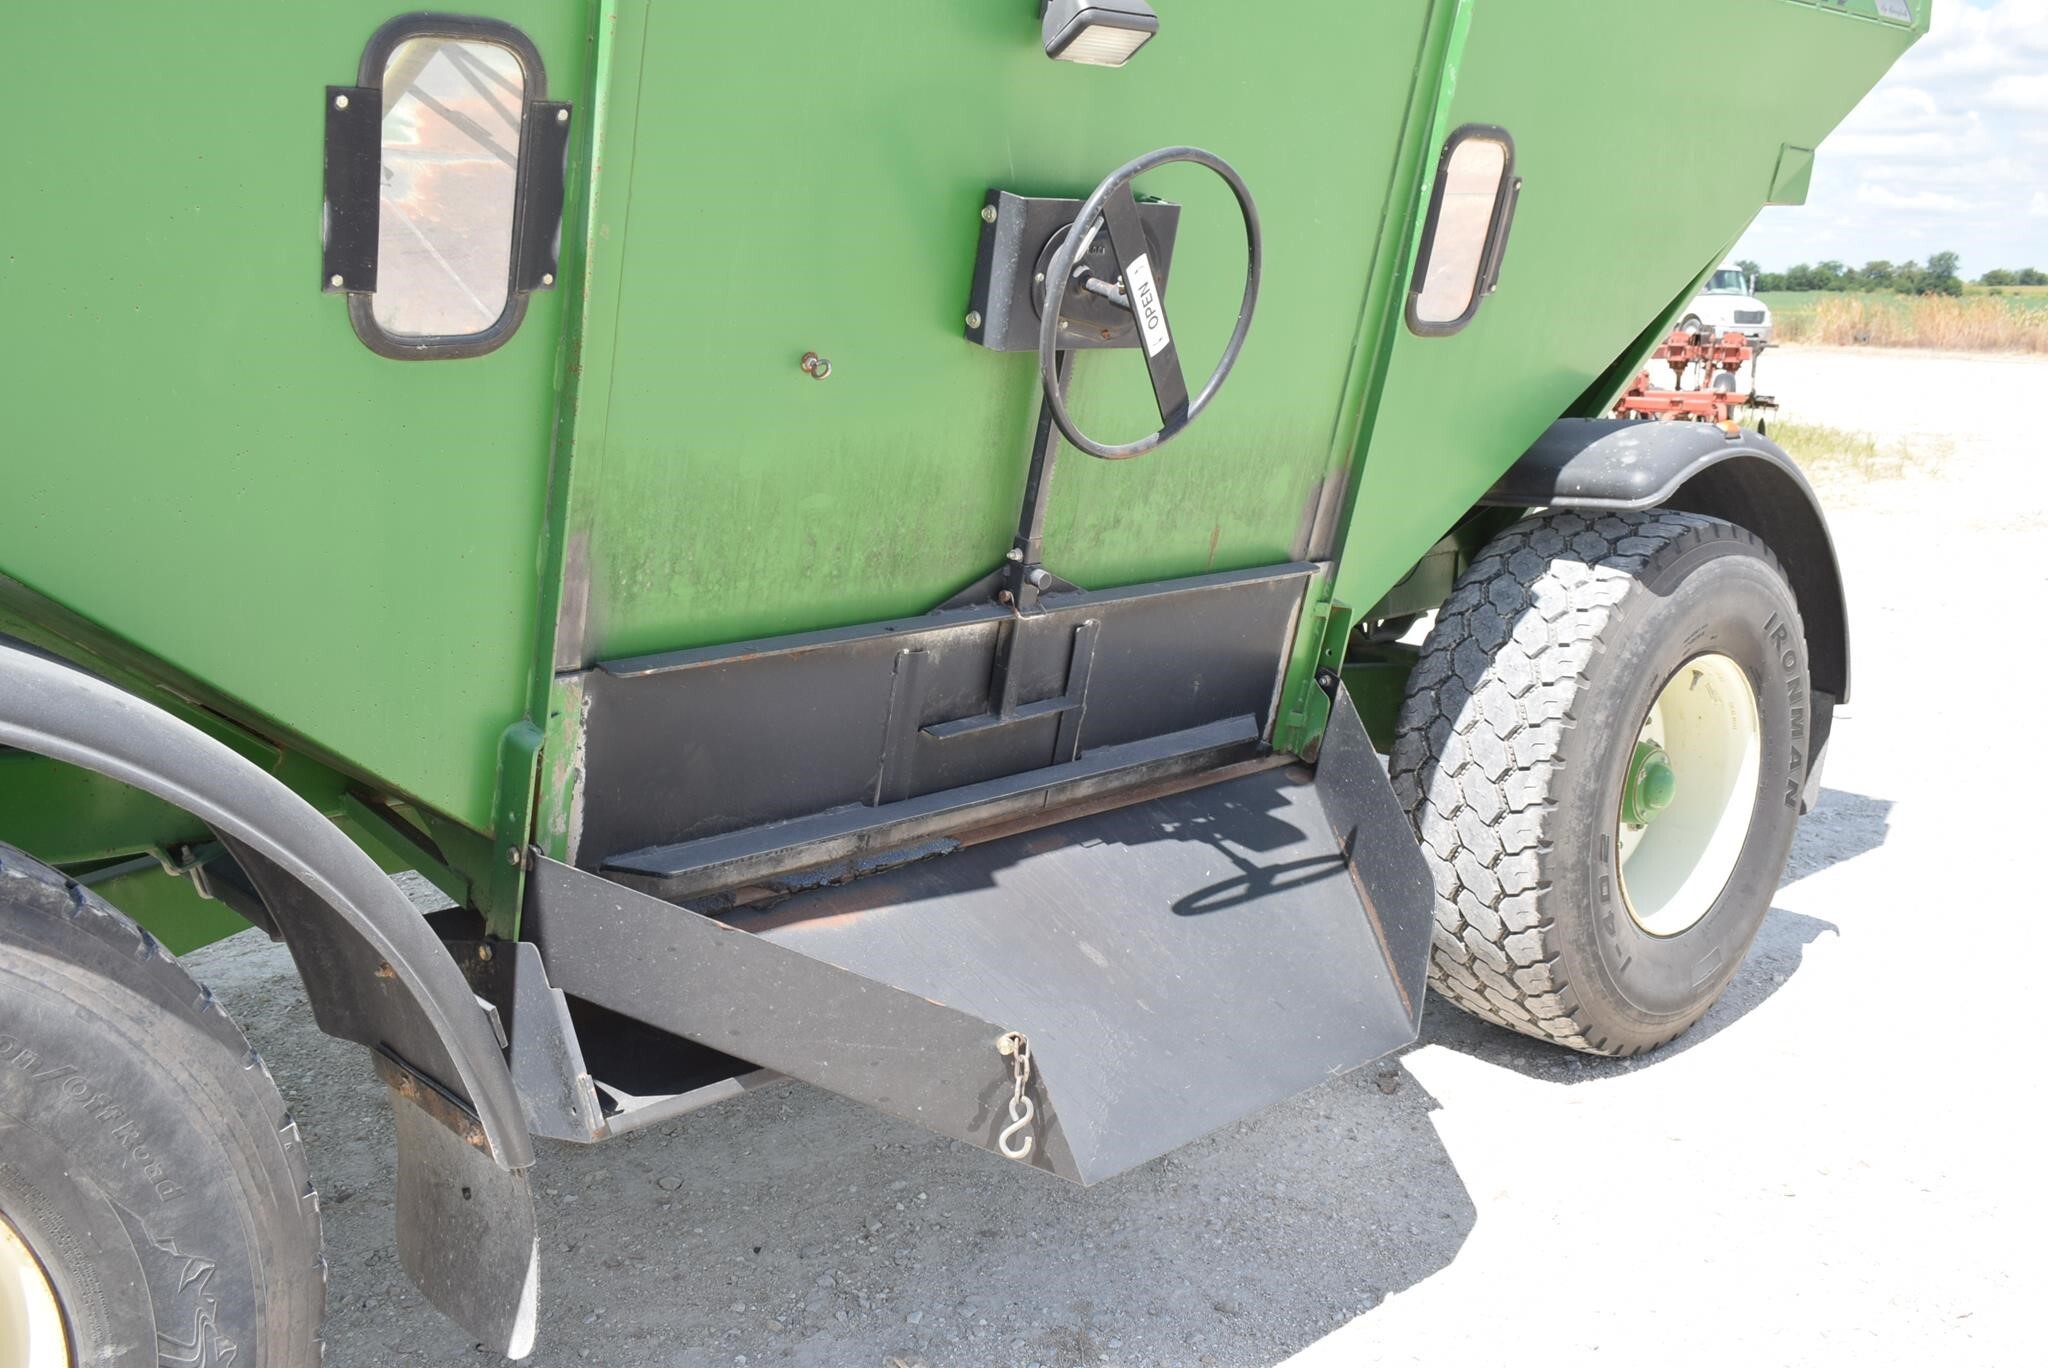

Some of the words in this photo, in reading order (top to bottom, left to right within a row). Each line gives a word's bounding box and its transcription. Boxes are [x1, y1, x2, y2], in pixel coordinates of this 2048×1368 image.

[1138, 281, 1159, 330] OPEN
[1763, 611, 1804, 808] IRONMAN
[111, 1120, 186, 1202] Road
